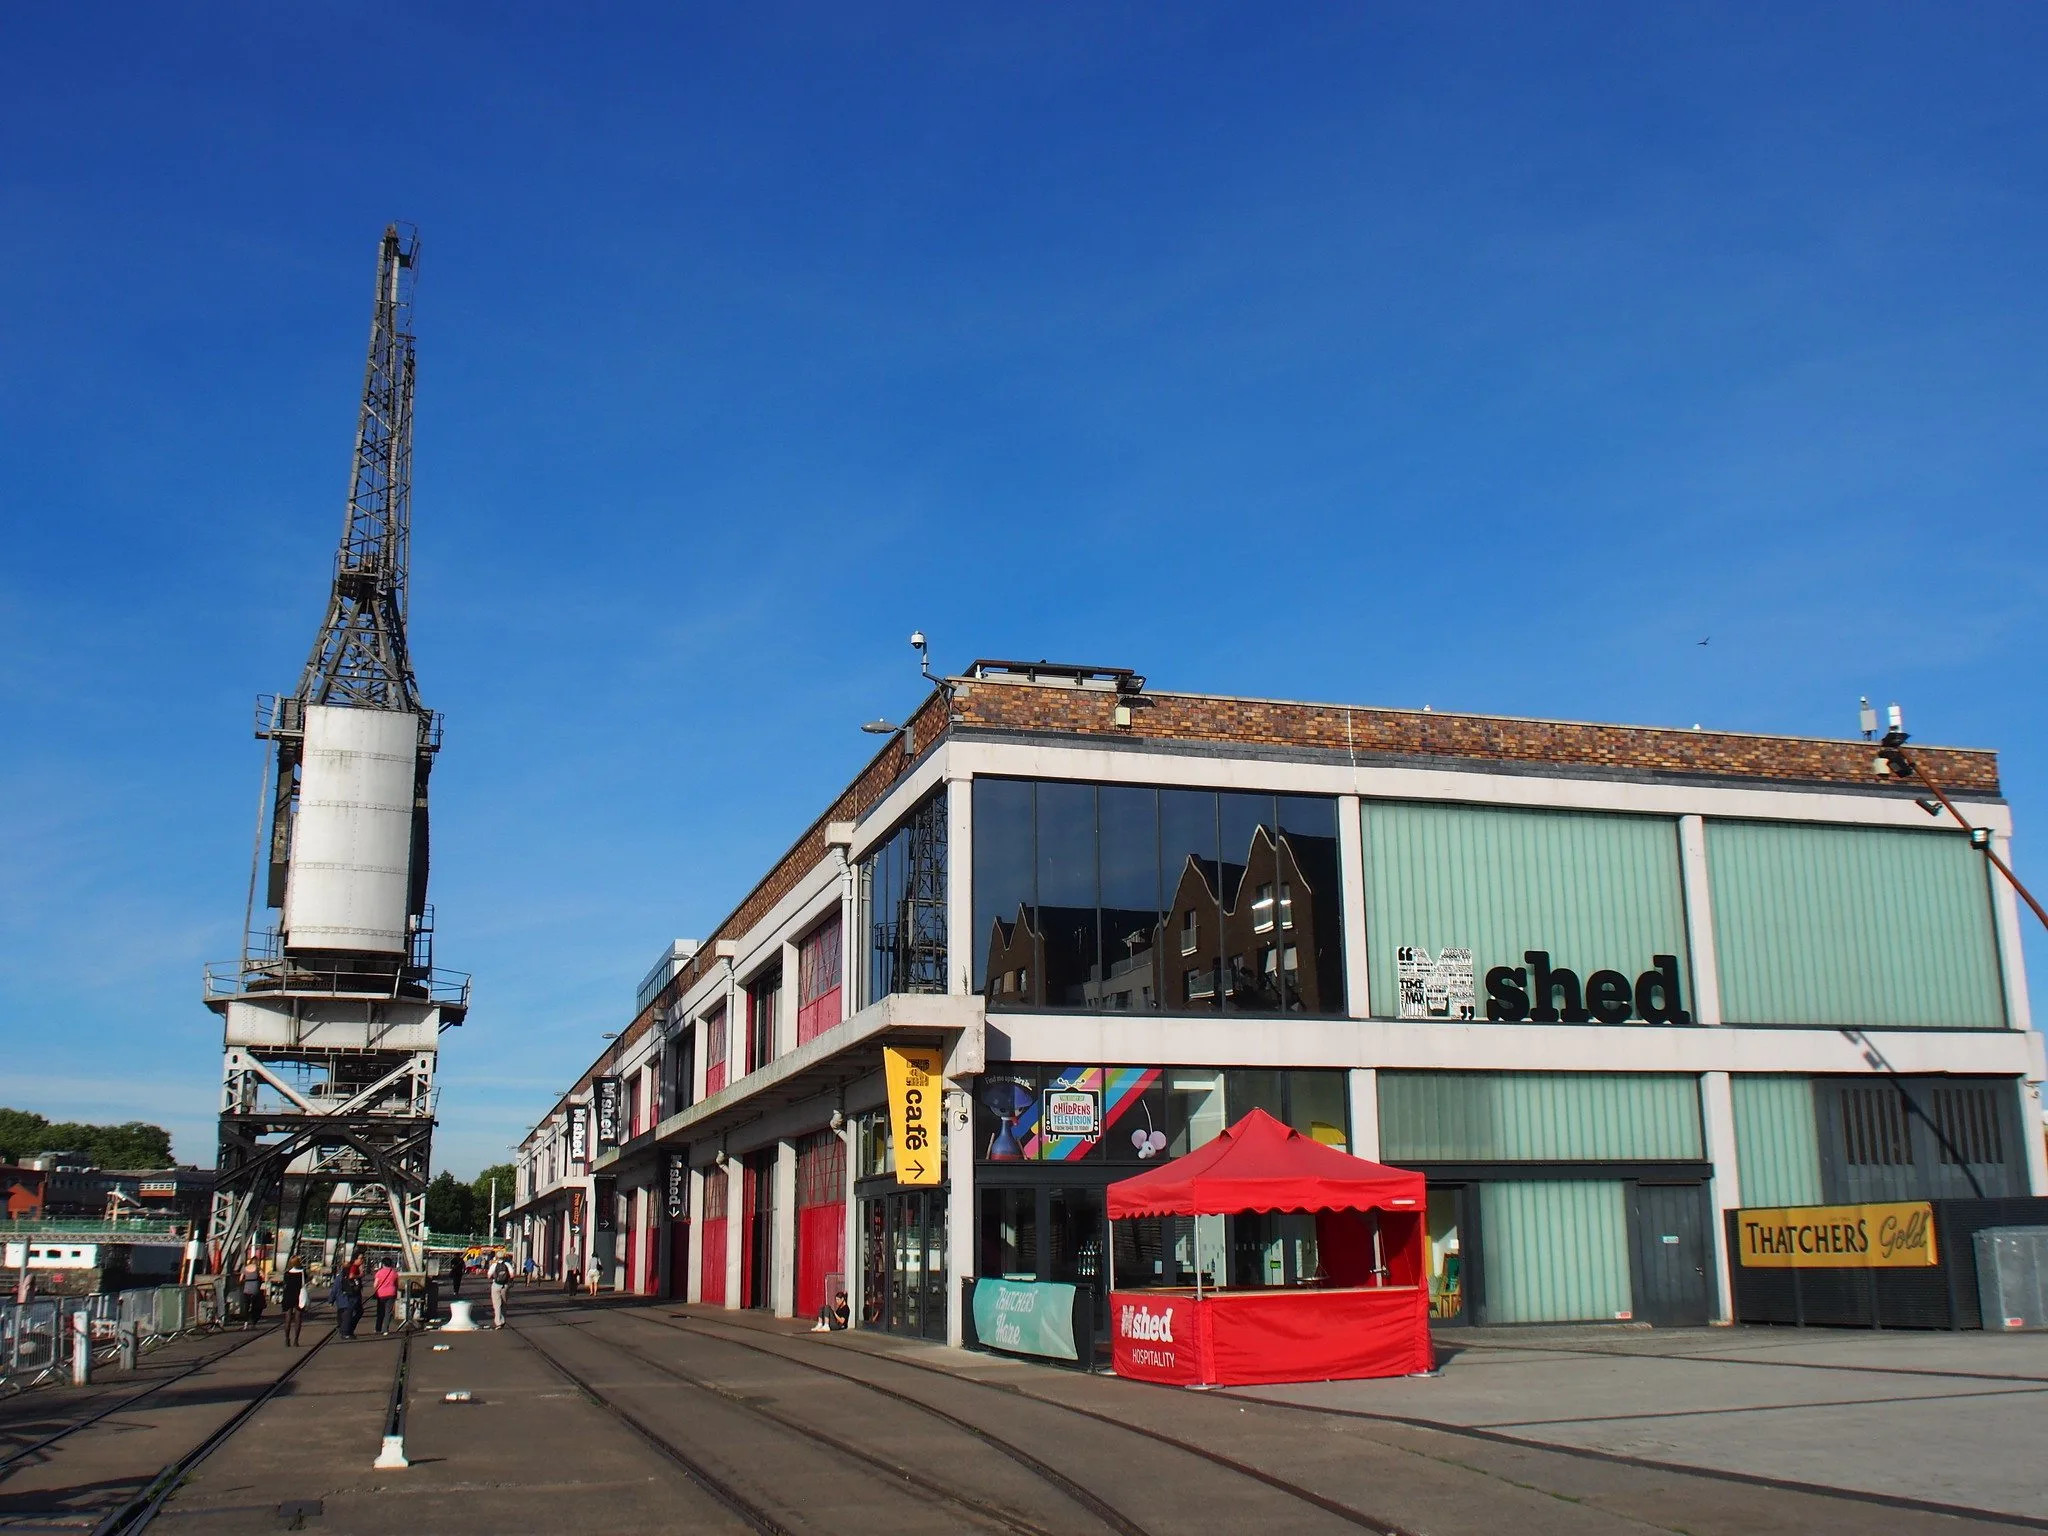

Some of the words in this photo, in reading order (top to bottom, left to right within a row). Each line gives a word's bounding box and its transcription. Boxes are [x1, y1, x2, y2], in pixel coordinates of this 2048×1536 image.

[1405, 991, 1426, 1005] MAX
[1485, 951, 1690, 1024] shed
[600, 1098, 616, 1140] shed
[905, 1089, 929, 1151] café
[1053, 1115, 1092, 1125] TELEVISION
[572, 1123, 585, 1158] shed
[668, 1168, 682, 1205] shed
[1745, 1219, 1869, 1254] THATCHERS
[1879, 1209, 1931, 1258] Gold
[995, 1313, 1021, 1345] Haze
[1132, 1306, 1174, 1342] shed
[1132, 1348, 1175, 1368] HOSPITALITY
